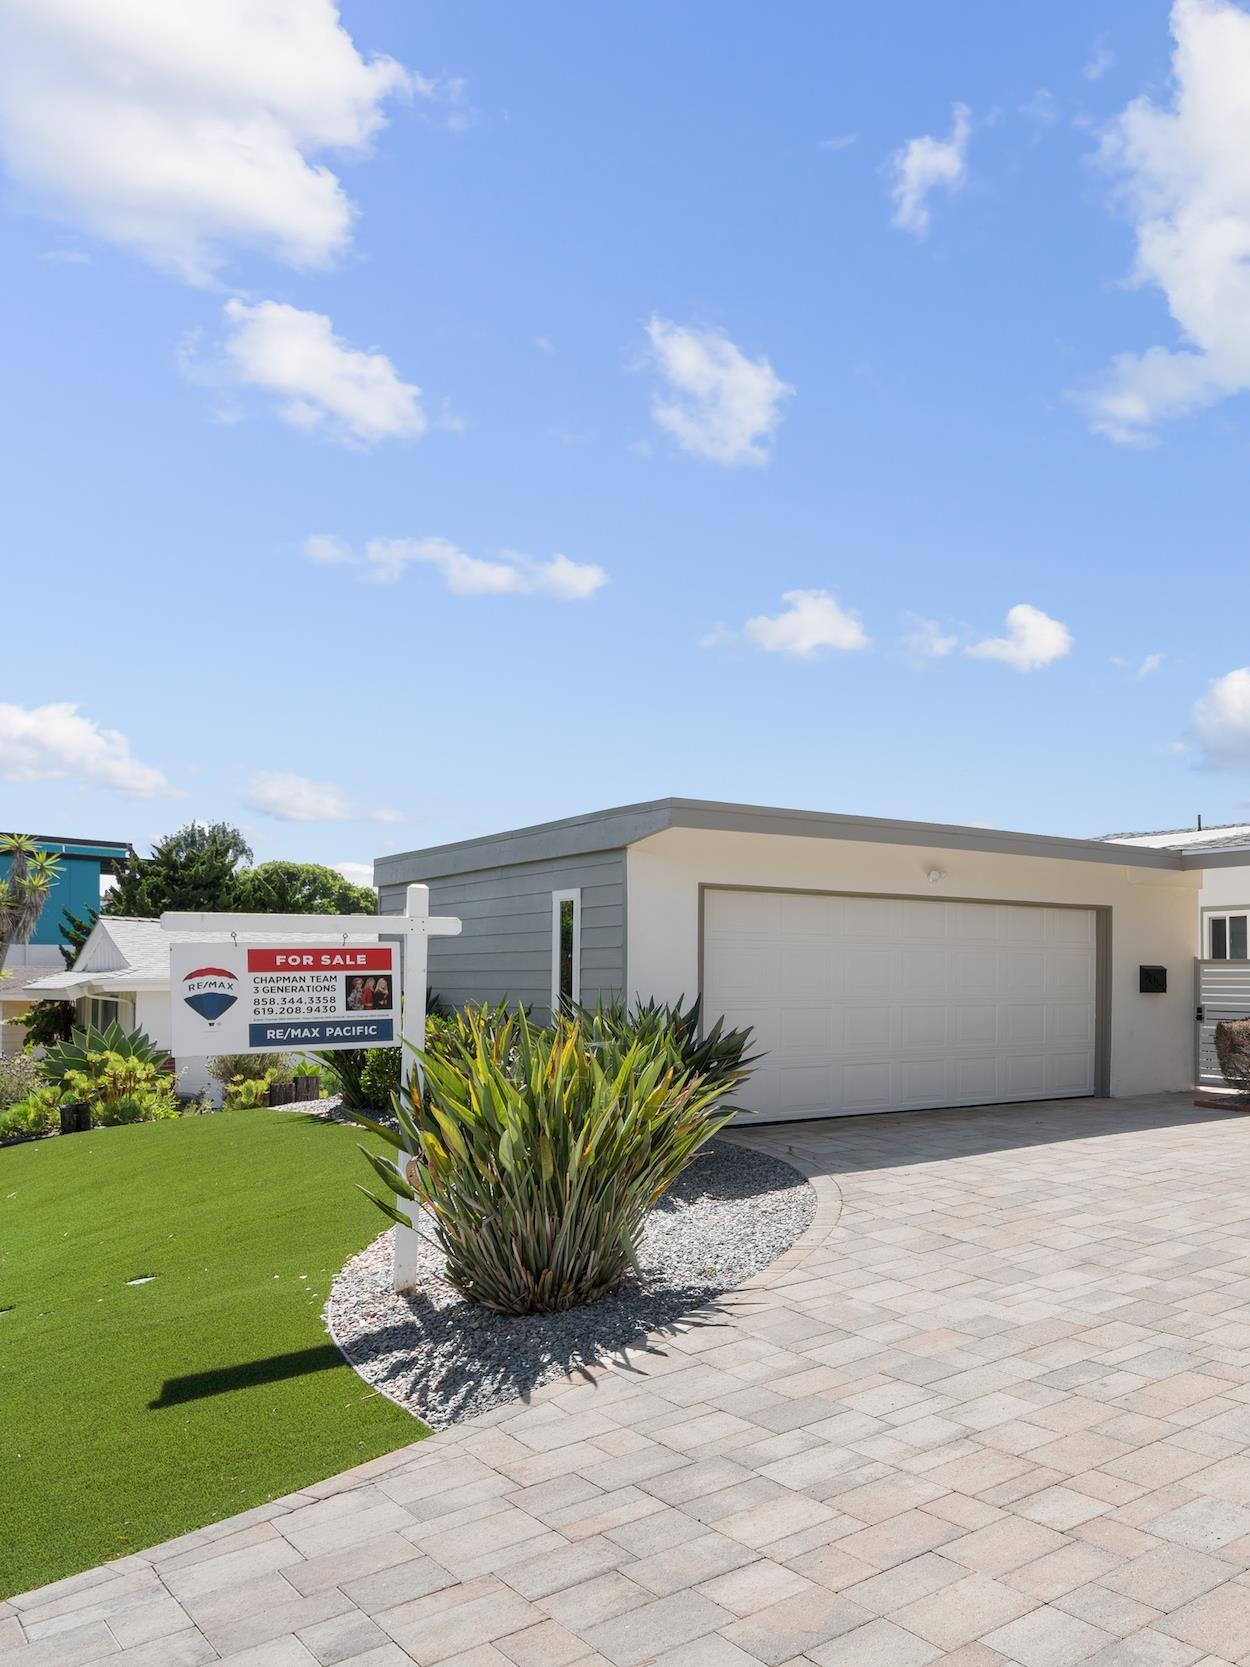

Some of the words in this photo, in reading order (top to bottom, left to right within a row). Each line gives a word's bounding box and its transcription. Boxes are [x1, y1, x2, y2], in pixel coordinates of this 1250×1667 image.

[276, 955, 314, 966] FOR
[321, 954, 367, 966] SALE
[253, 976, 308, 984] CHAPMAN
[310, 975, 338, 984] TEAM
[188, 981, 234, 992] RE/MAX
[262, 984, 337, 994] GENERATIONS
[253, 996, 337, 1005] 858.344.3358
[253, 1006, 337, 1015] 619.208.9430
[266, 1028, 321, 1040] RE/MAX
[326, 1025, 378, 1037] PACIFIC
